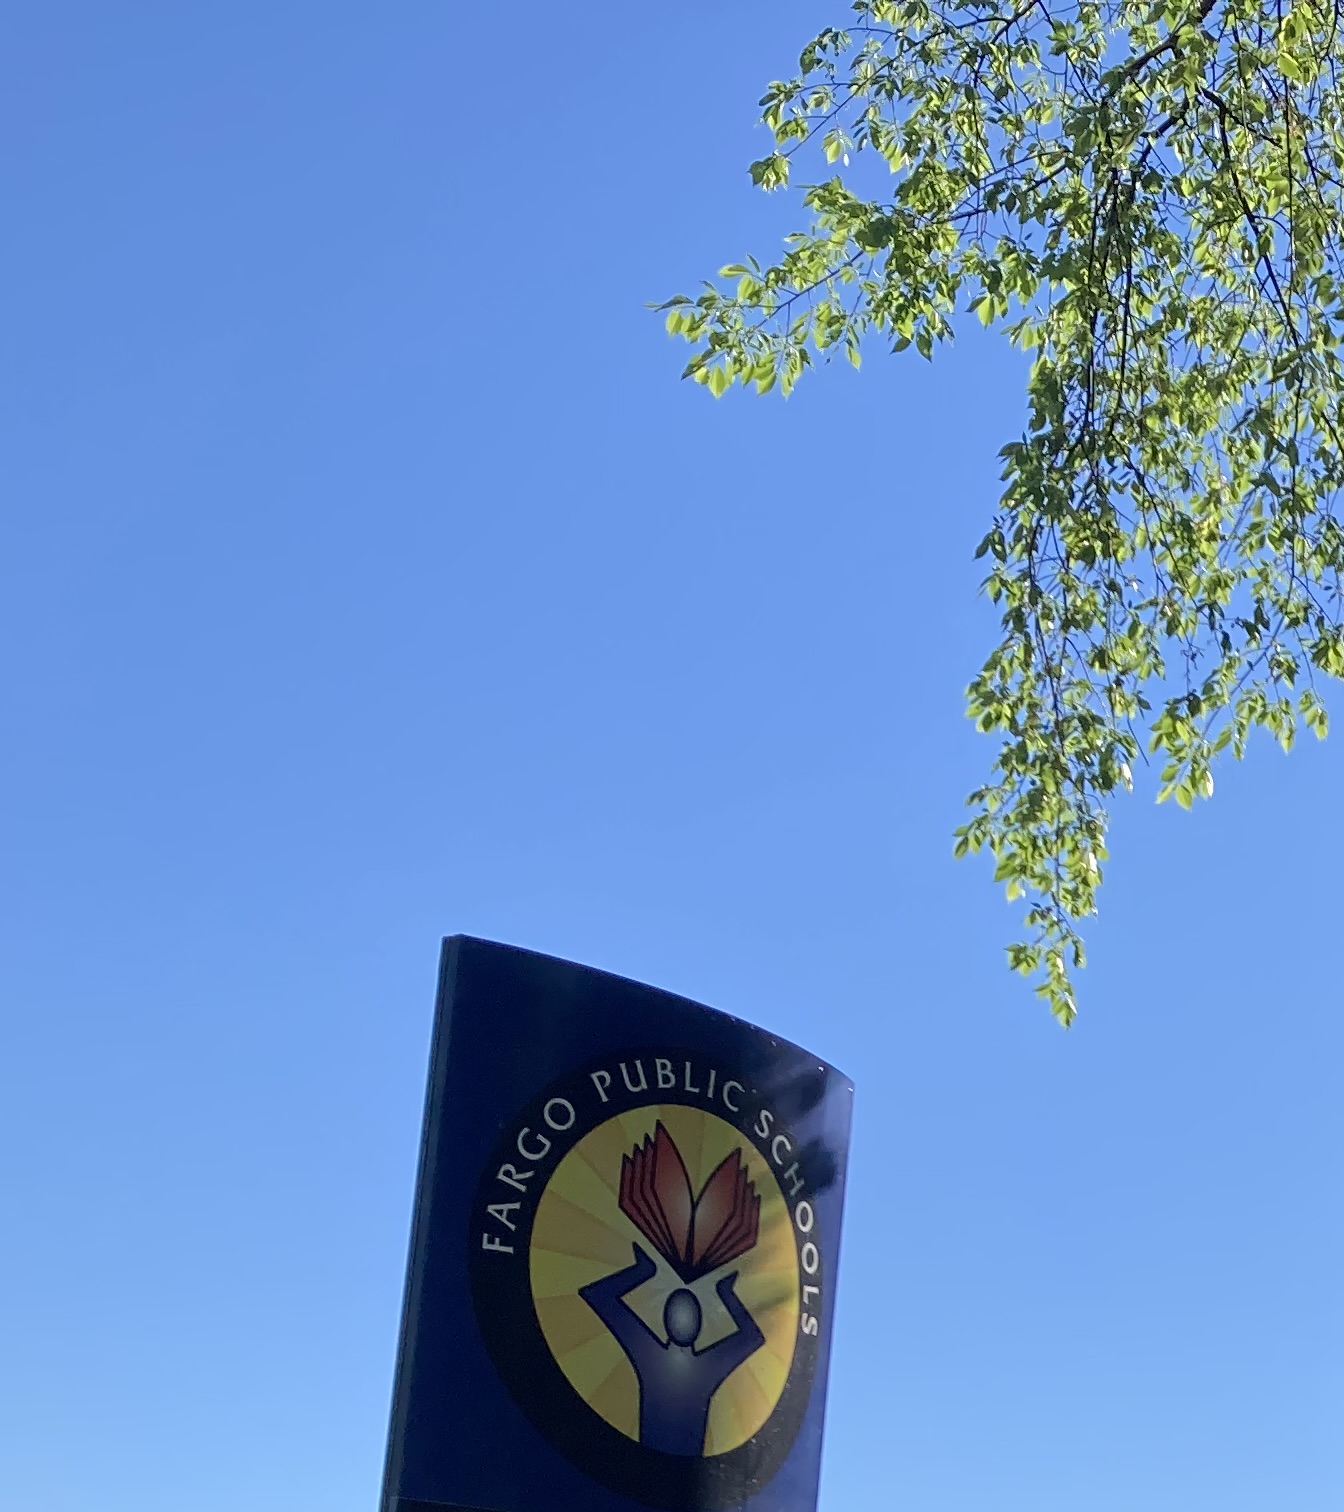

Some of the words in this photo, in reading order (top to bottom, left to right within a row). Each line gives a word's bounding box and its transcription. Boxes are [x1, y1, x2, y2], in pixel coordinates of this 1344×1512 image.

[482, 1097, 576, 1255] FARGO
[590, 1058, 746, 1112] PUBLIC
[753, 1109, 820, 1338] SCHOOLS
